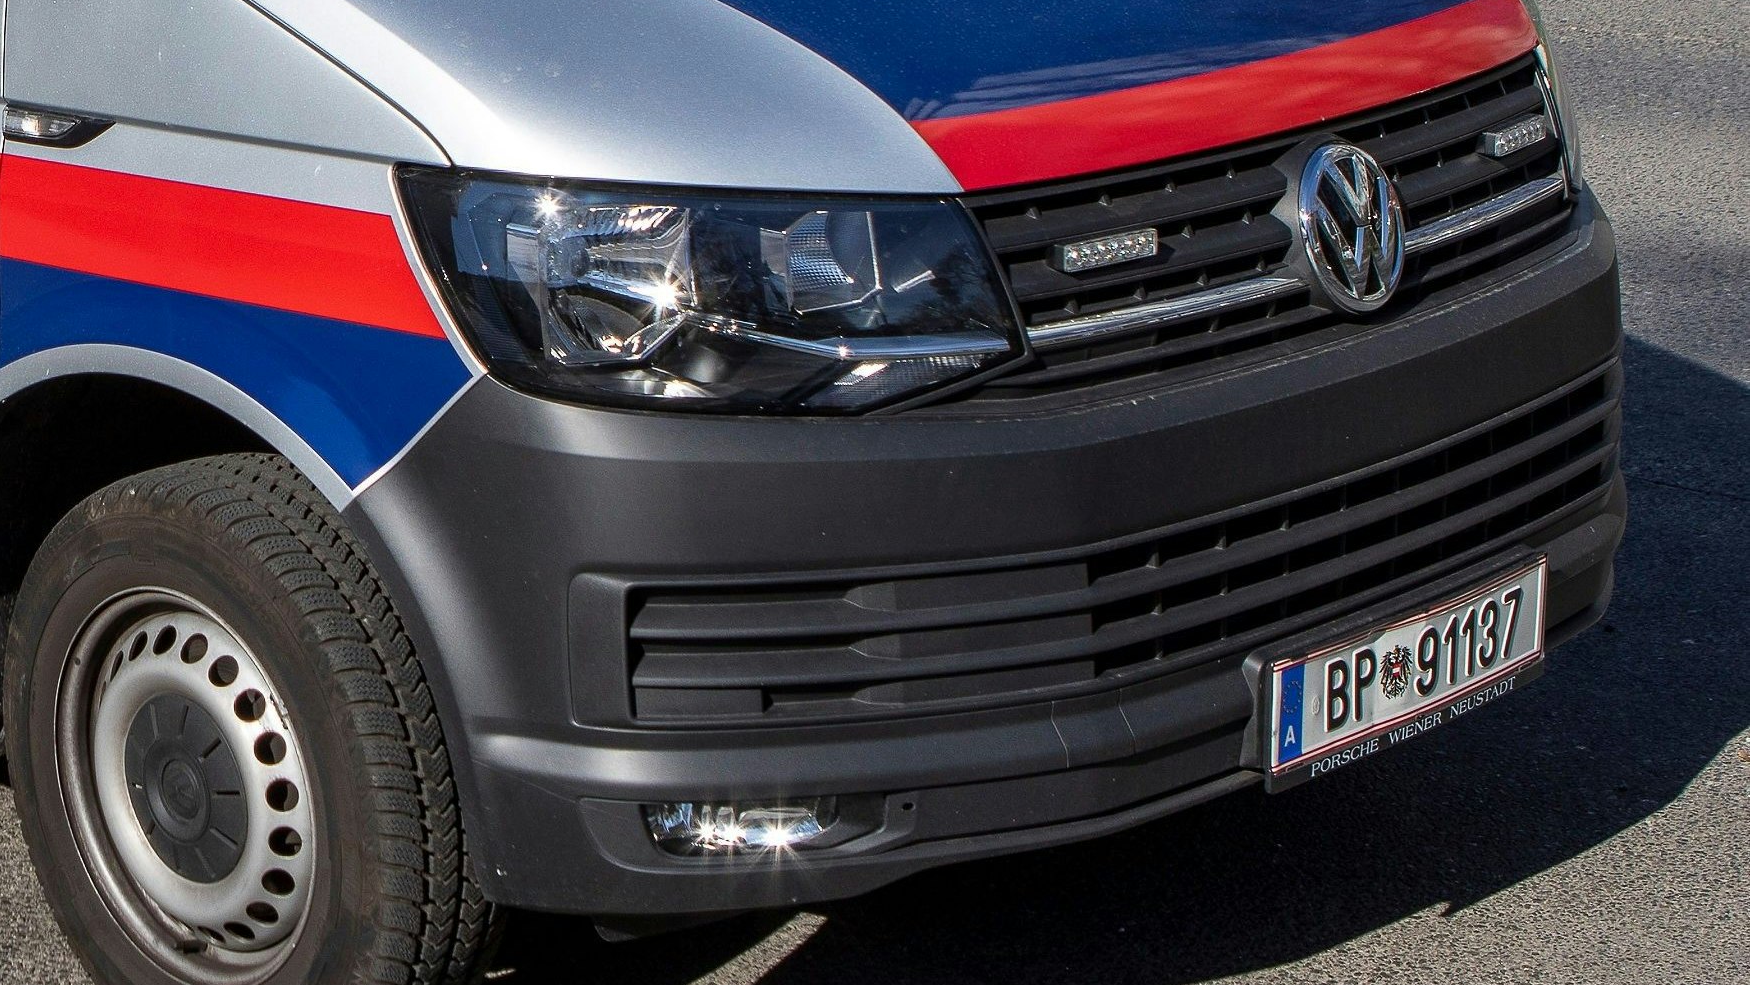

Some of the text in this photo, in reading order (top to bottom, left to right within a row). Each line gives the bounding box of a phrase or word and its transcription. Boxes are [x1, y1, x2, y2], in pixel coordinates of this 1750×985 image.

[1323, 584, 1524, 733] BP 91137
[1284, 725, 1296, 747] A
[1310, 676, 1517, 778] PORSCHE WIENER NEUSTADT
